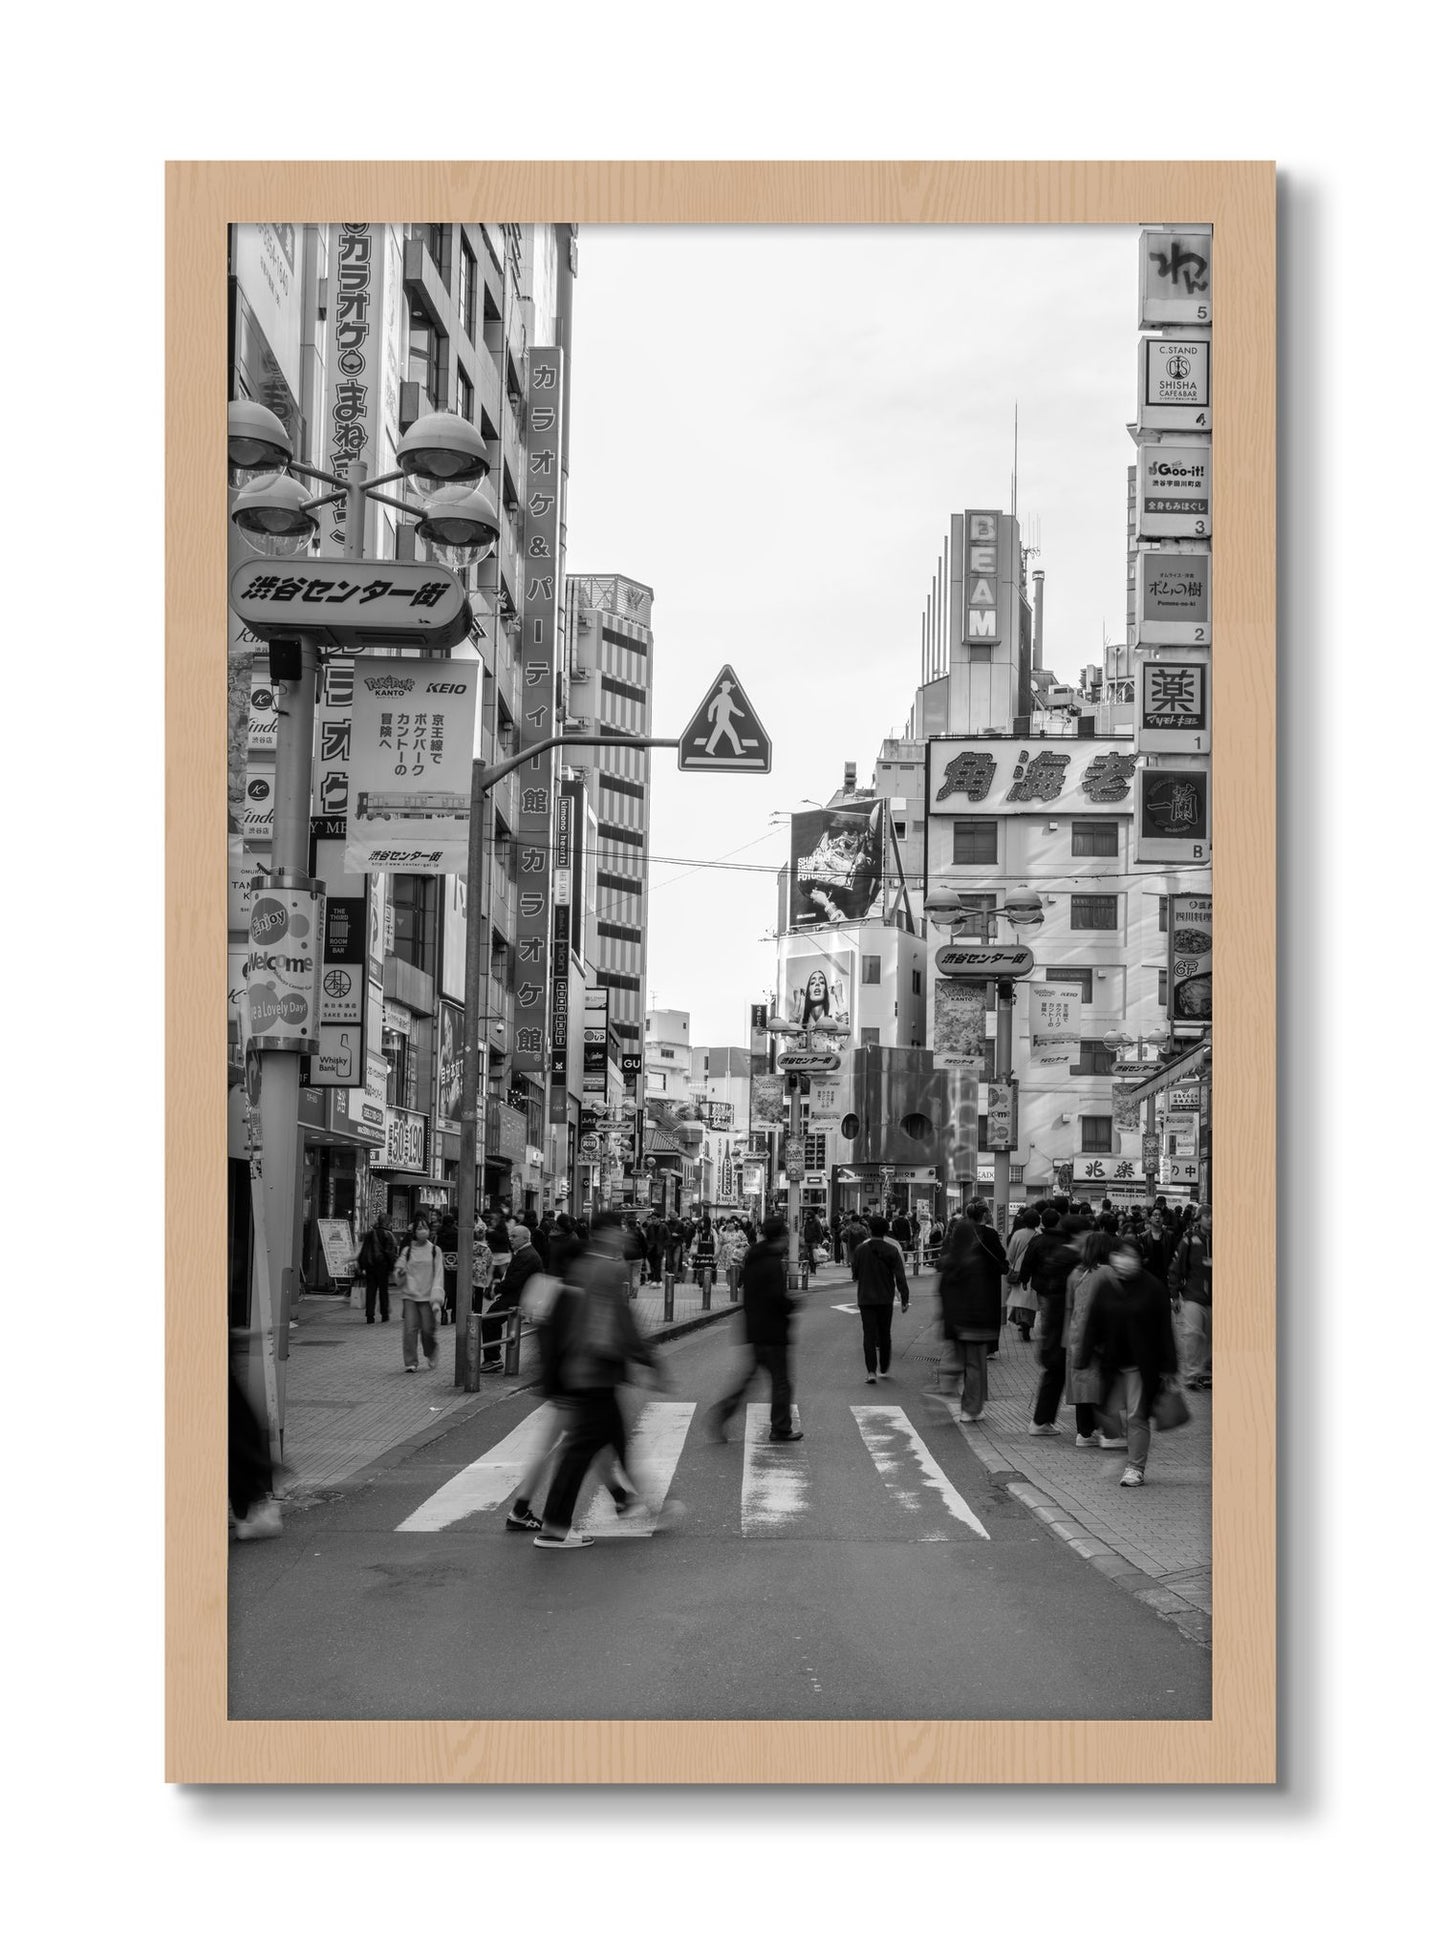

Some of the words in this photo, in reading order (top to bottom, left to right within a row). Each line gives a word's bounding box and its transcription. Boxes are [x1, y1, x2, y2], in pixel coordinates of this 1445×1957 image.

[337, 235, 371, 351] カラオケ
[1197, 306, 1207, 319] 5
[1159, 346, 1198, 355] C.STAND
[1159, 380, 1197, 390] SHISHA
[1196, 413, 1206, 426] 4
[1158, 463, 1204, 477] Goo-it!
[1148, 501, 1205, 511] 全身もみほぐし
[1195, 520, 1205, 534] 3
[969, 515, 998, 636] BEAM
[241, 575, 451, 607] 渋谷センター街
[1194, 628, 1204, 641] 2
[426, 683, 467, 694] KEIO
[1152, 669, 1194, 712] 薬
[379, 713, 393, 749] 冒険へ
[252, 736, 273, 744] 渋谷店
[394, 713, 410, 776] カントーの
[430, 714, 444, 764] 京王線で
[1194, 736, 1201, 750] 1
[936, 750, 1137, 802] 角海老
[1147, 783, 1198, 825] 一蘭
[560, 801, 568, 831] kimono
[369, 850, 443, 862] 渋谷センター街
[559, 835, 567, 864] hearts
[1193, 845, 1203, 858] B
[252, 909, 285, 938] Enjoy
[517, 847, 546, 1053] カラオケ館
[248, 952, 313, 973] Welcome
[942, 953, 1028, 964] 渋谷センター街
[1174, 960, 1198, 977] 6F
[262, 1001, 288, 1018] Lovely
[289, 1001, 307, 1014] Day!
[319, 1064, 336, 1072] Bank
[320, 1056, 348, 1066] Whisky
[624, 1059, 640, 1068] GU
